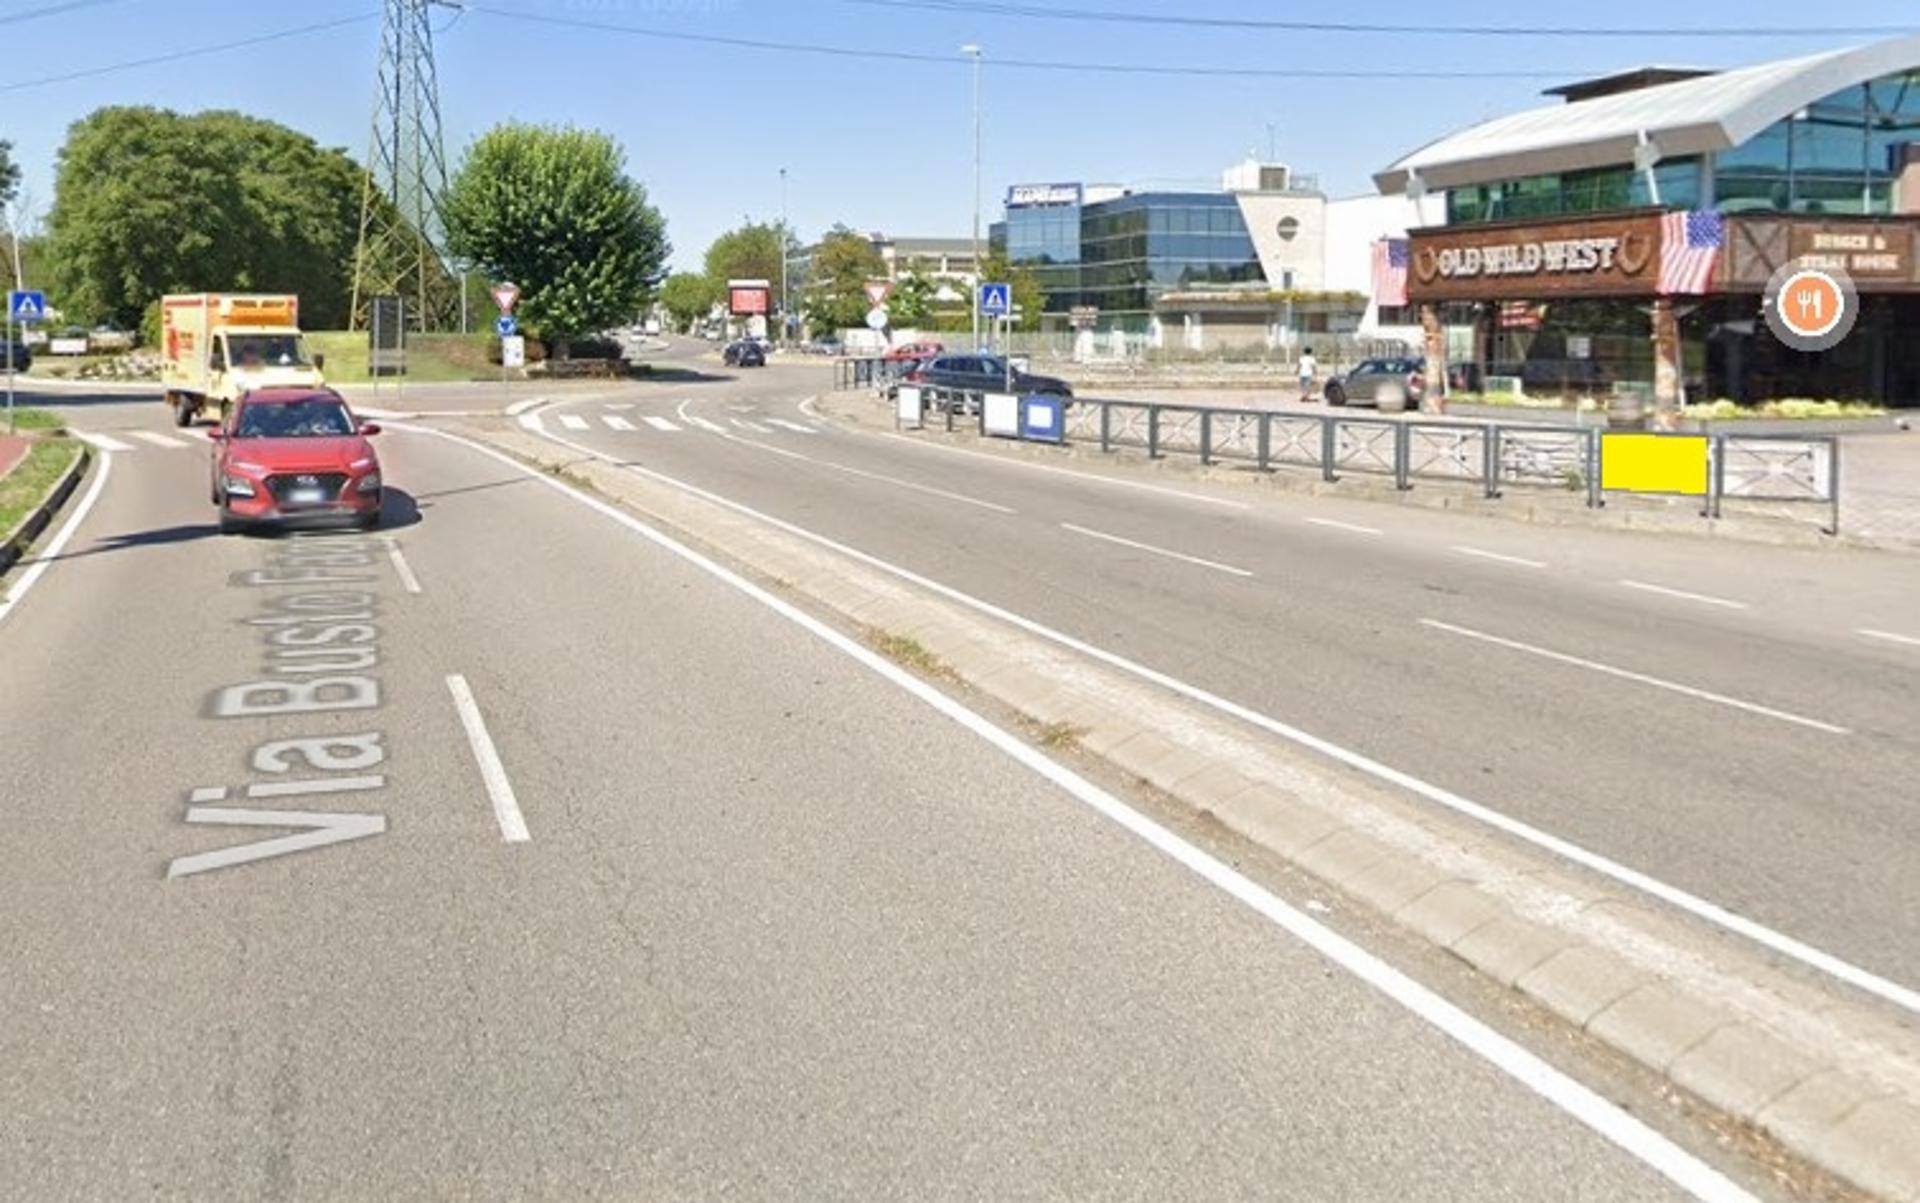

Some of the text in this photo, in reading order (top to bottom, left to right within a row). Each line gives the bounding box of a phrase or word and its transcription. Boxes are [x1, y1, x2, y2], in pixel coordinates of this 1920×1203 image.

[1438, 237, 1620, 277] OLD WILD WEST
